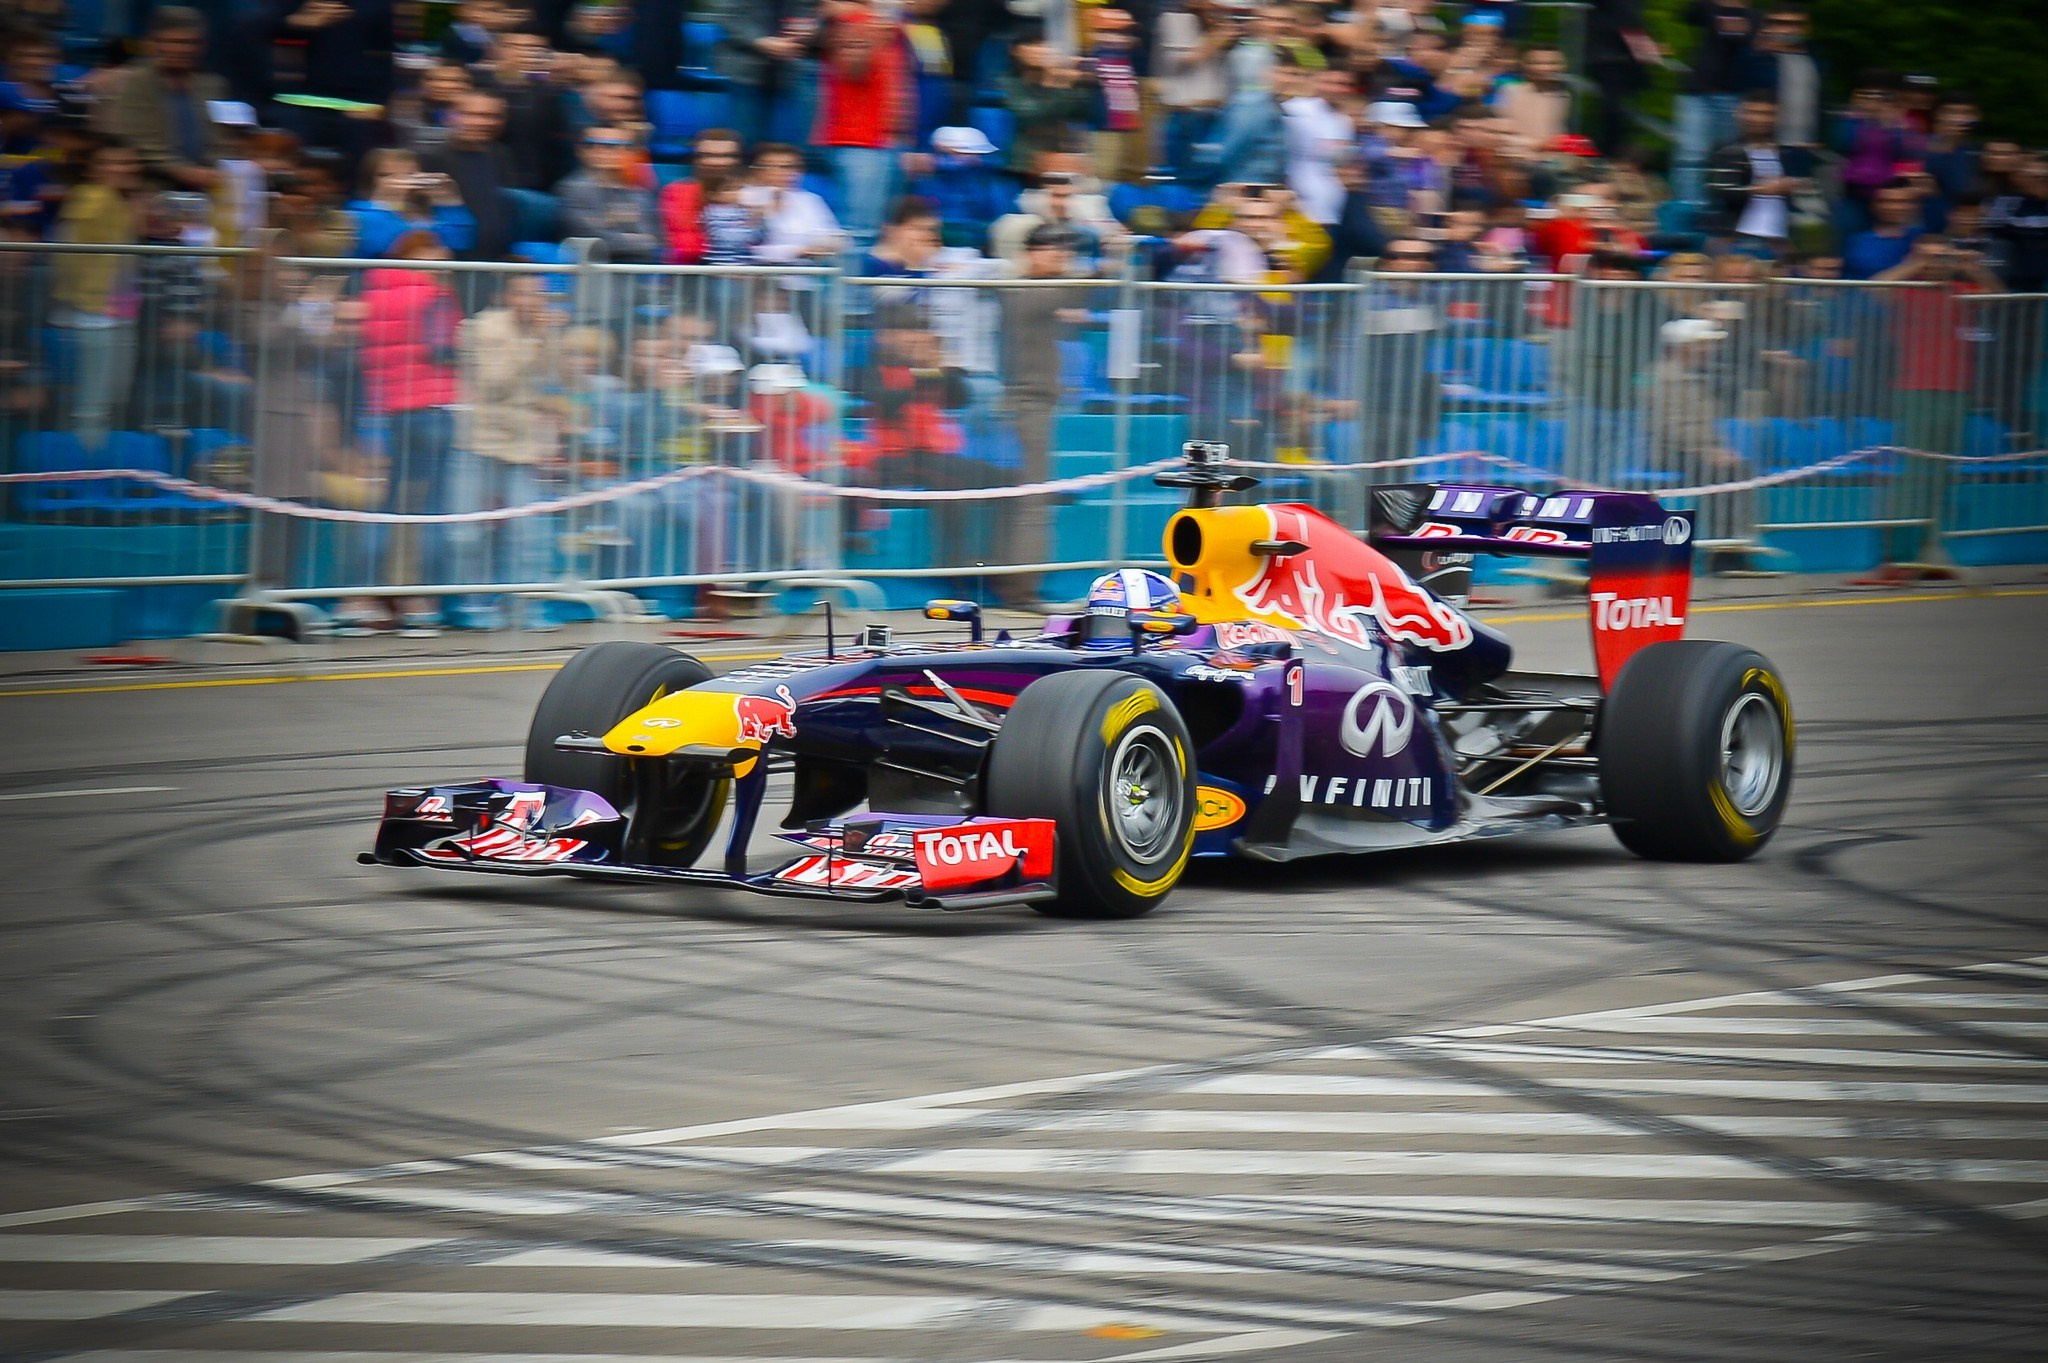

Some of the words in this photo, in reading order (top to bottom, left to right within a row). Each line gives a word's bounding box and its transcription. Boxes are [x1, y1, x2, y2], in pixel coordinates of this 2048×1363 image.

[1591, 592, 1685, 631] TOTAL
[1286, 665, 1304, 706] 1
[917, 829, 1029, 867] TOTAL
